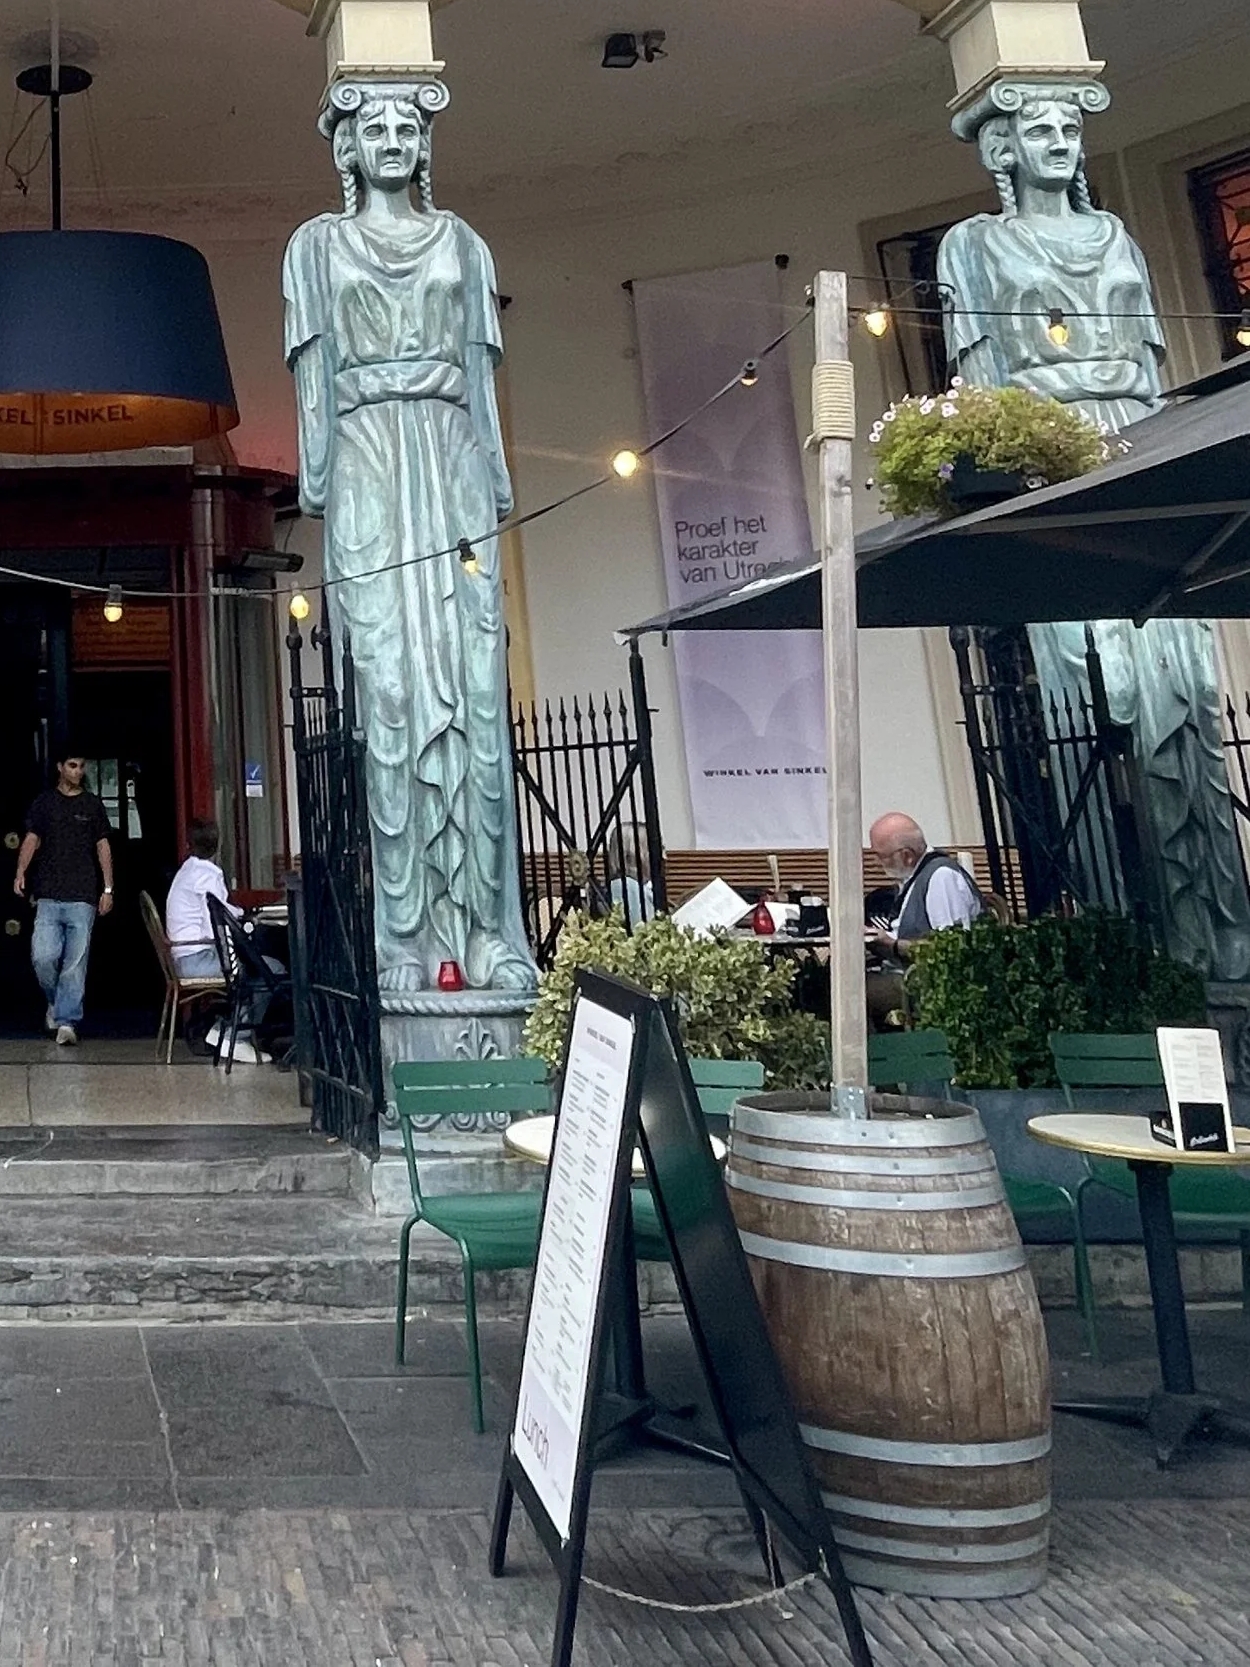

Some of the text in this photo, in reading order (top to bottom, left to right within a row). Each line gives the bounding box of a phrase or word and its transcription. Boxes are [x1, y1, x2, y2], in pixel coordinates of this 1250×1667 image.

[52, 405, 134, 425] SINKEL
[675, 515, 767, 539] Proef het
[677, 539, 759, 562] karakter
[680, 557, 797, 583] van Utre
[521, 1393, 550, 1471] Lunch
